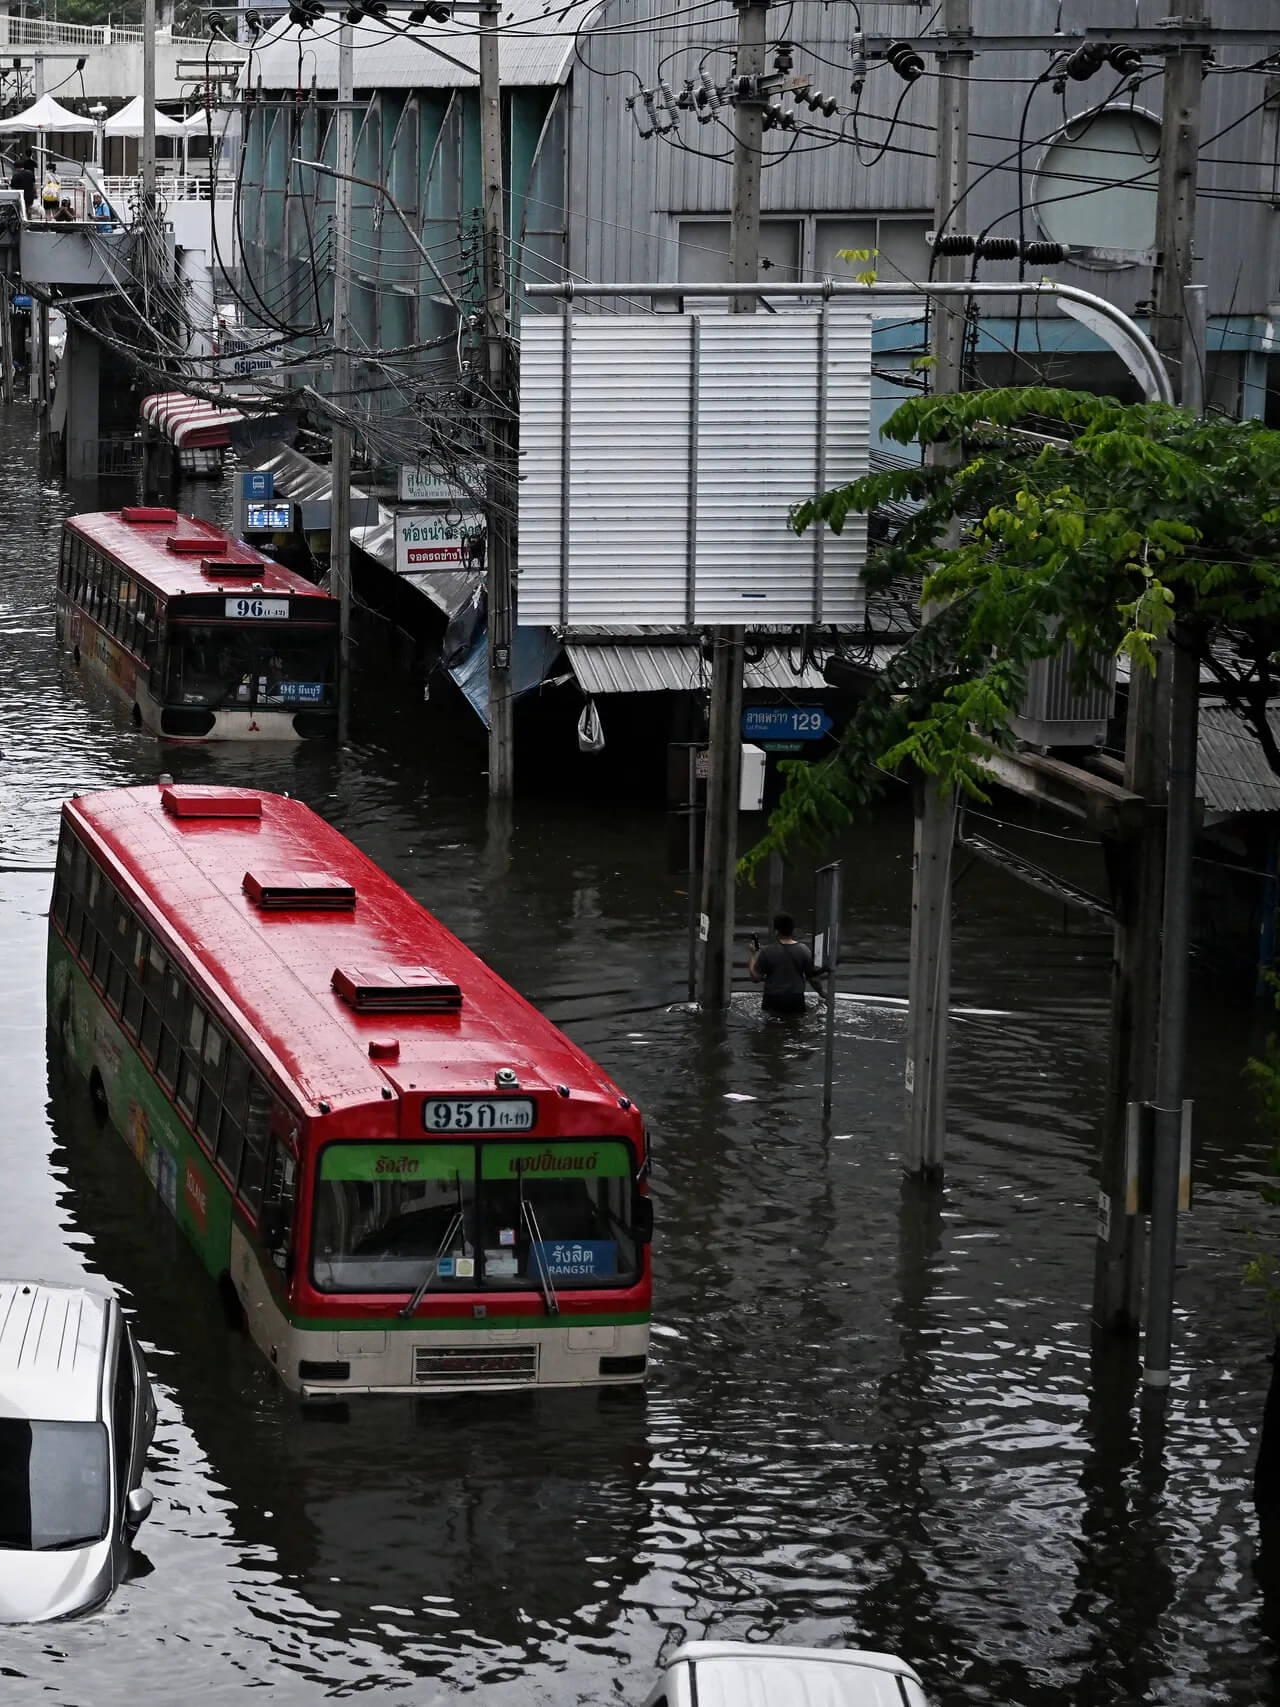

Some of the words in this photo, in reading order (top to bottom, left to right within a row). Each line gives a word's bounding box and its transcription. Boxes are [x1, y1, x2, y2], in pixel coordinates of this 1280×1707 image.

[237, 600, 263, 616] 96
[280, 684, 296, 694] 96
[747, 709, 788, 724] ลาดพร้าว
[792, 713, 821, 730] 129
[434, 1103, 496, 1128] 95ก
[375, 1154, 419, 1173] รังสิต
[552, 1244, 594, 1263] รังสิต
[548, 1264, 595, 1275] RANGSIT
